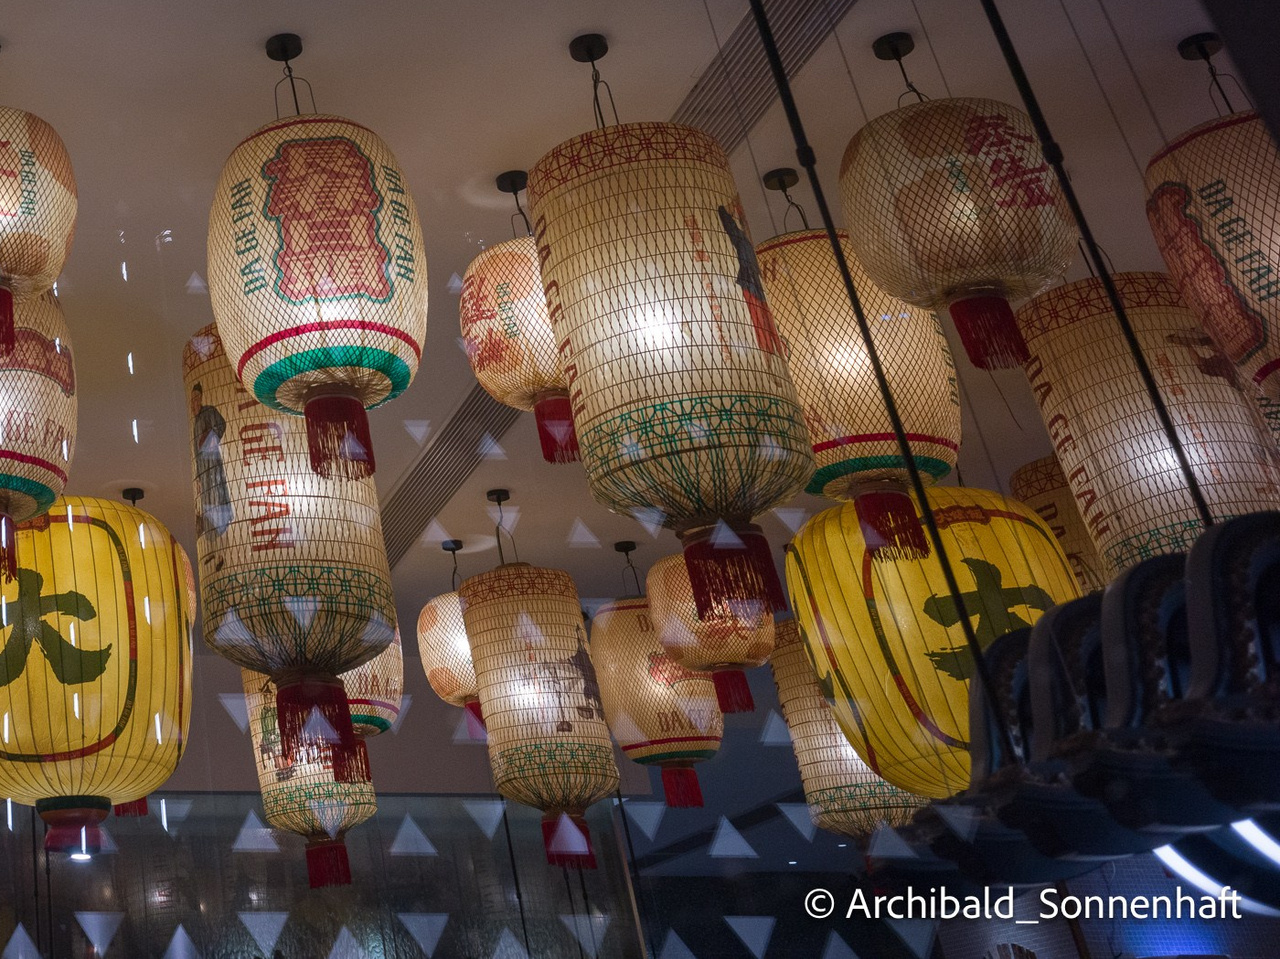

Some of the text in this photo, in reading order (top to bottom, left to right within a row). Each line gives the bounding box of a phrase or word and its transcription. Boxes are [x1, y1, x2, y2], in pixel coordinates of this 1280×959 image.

[230, 177, 267, 296] DA GE FAN
[382, 164, 416, 283] DA GE FAN
[1198, 179, 1234, 218] DA
[1217, 217, 1255, 252] GE
[5, 409, 38, 444] GE
[239, 422, 286, 467] GE
[1026, 354, 1110, 542] DA GE FAN
[246, 479, 295, 552] FAN
[1035, 502, 1066, 538] DA
[357, 673, 381, 695] DA
